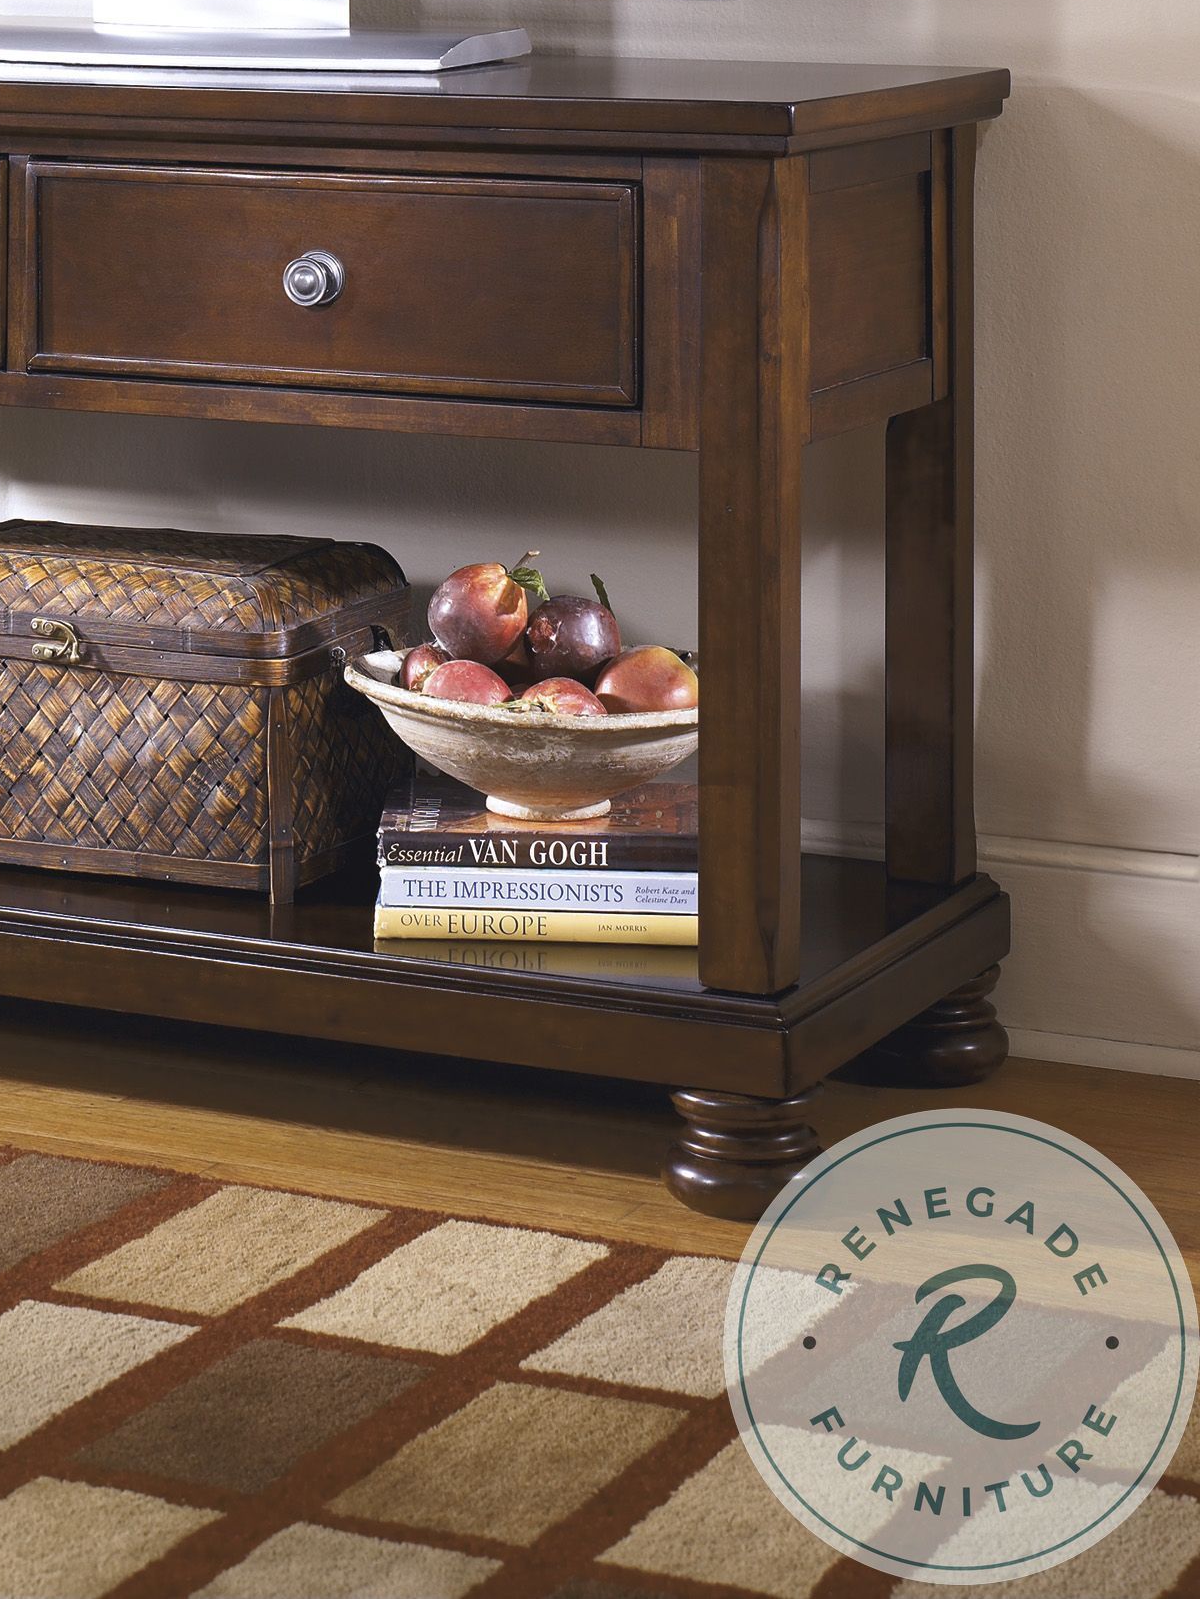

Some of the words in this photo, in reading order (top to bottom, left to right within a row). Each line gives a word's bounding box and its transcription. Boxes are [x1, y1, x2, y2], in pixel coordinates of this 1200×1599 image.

[386, 843, 464, 863] Essential
[468, 838, 519, 865] VAN
[529, 840, 609, 866] GOGH
[402, 879, 447, 899] THE
[453, 881, 625, 903] IMPRESSIONISTS
[635, 886, 660, 894] Robert
[662, 887, 679, 895] Katz
[681, 887, 695, 895] and
[400, 913, 443, 928] OVER
[447, 915, 548, 937] EUROPE
[598, 924, 612, 933] JAN
[615, 924, 647, 932] MORRIS
